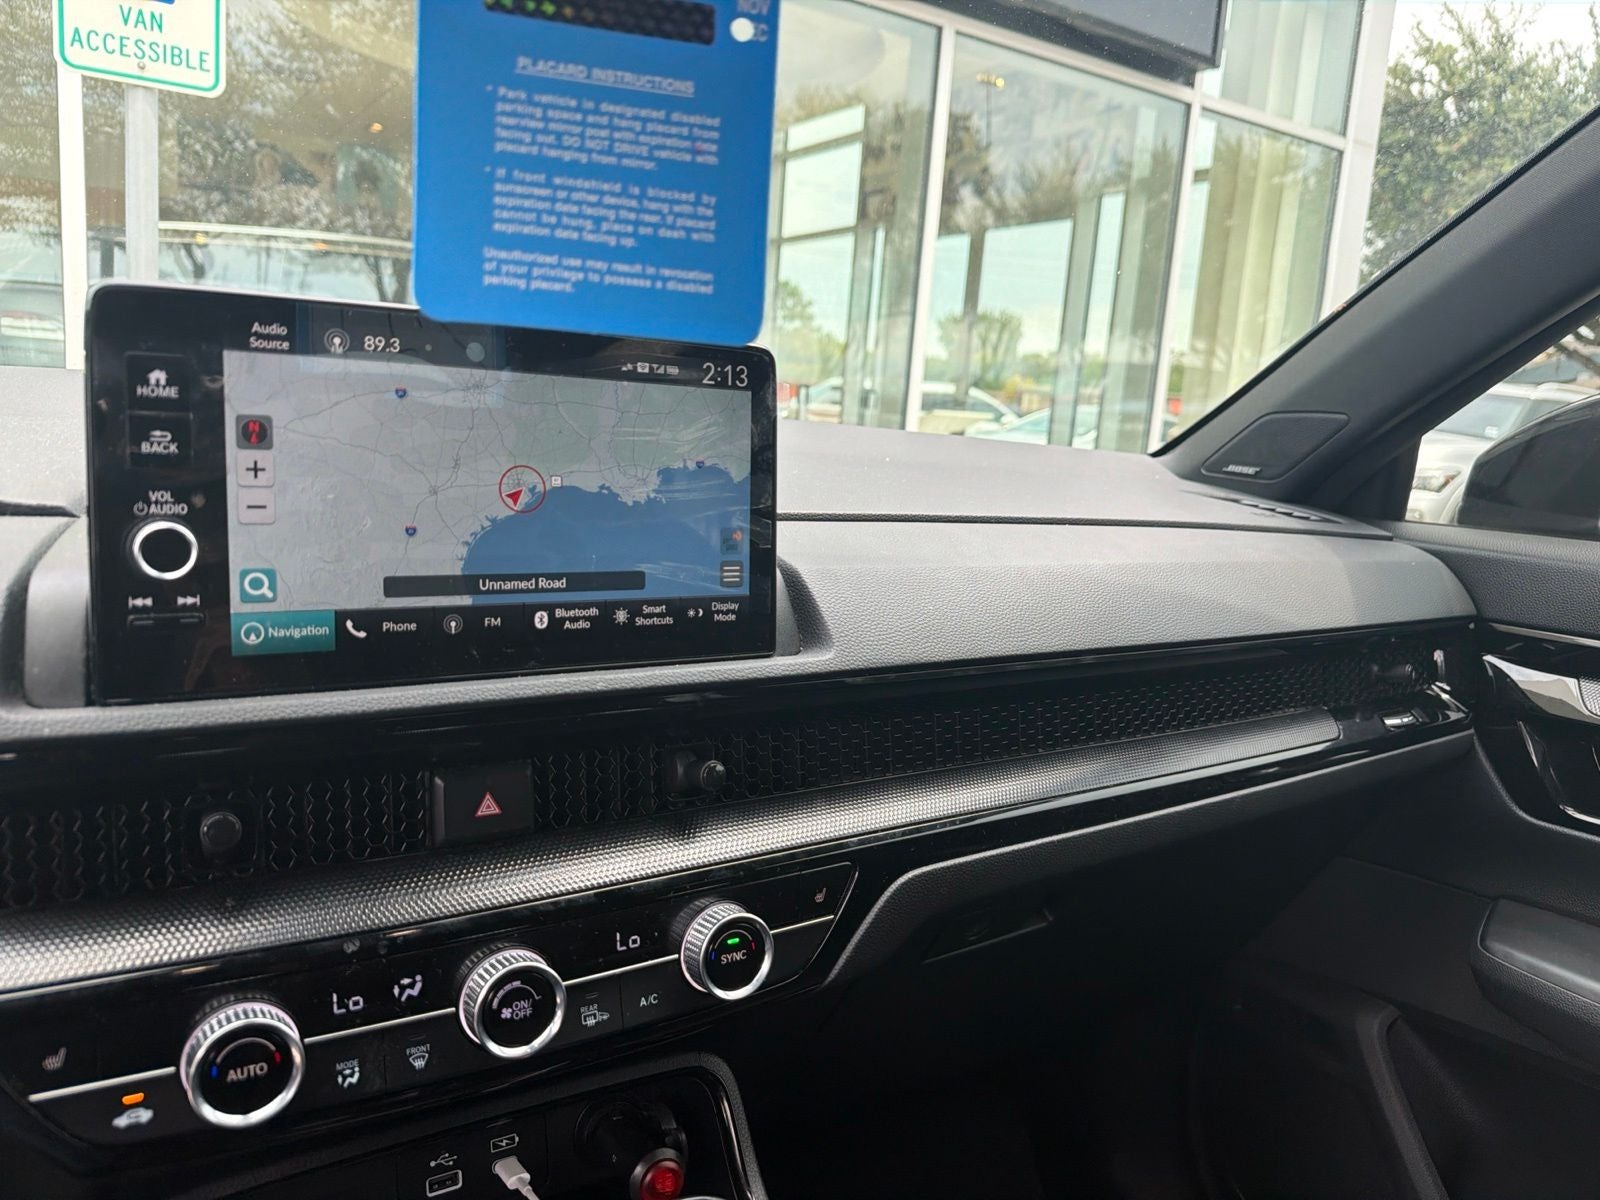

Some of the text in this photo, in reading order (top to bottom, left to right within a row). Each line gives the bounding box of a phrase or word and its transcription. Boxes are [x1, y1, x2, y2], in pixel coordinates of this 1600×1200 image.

[120, 5, 163, 33] VAN
[70, 27, 211, 73] ACCESSIBLE
[516, 58, 694, 96] PLACARD INSTRUCTIONS
[499, 87, 721, 127] Park vehicle in designated disabled
[496, 101, 719, 140] parking space and hang placard from
[639, 134, 692, 151] expiration
[495, 140, 538, 158] placard
[543, 147, 588, 164] hanging
[591, 153, 618, 166] from
[563, 135, 581, 148] DO
[586, 138, 609, 151] NOT
[614, 142, 649, 157] DRIVE
[697, 154, 718, 166] with
[514, 170, 546, 184] front
[553, 176, 621, 193] windshield
[630, 185, 640, 196] is
[648, 187, 696, 203] blocked
[703, 194, 717, 207] by
[556, 190, 568, 200] or
[571, 192, 599, 204] other
[494, 195, 552, 212] expiration
[583, 205, 616, 221] facing
[676, 217, 716, 231] placard
[494, 208, 537, 222] cannot
[541, 213, 557, 225] be
[602, 221, 634, 235] place
[639, 226, 654, 236] on
[659, 227, 686, 240] dash
[692, 231, 715, 243] with
[494, 222, 551, 238] expiration
[555, 228, 579, 240] date
[583, 232, 616, 247] facing
[484, 246, 559, 266] Unauthorized
[563, 257, 582, 268] use
[587, 260, 609, 273] may
[660, 267, 714, 282] revocation
[484, 260, 497, 272] of
[502, 263, 528, 276] your
[532, 266, 584, 283] privilege
[589, 272, 600, 283] to
[656, 281, 662, 290] a
[667, 280, 714, 295] disabled
[484, 274, 527, 290] parking
[251, 321, 288, 335] Audio
[249, 336, 290, 351] Source
[364, 336, 401, 353] 89.3
[702, 362, 749, 387] 2:13
[136, 384, 179, 399] HOME
[141, 440, 178, 455] BACK
[148, 490, 174, 503] VOL
[148, 502, 188, 516] AUDIO
[479, 577, 566, 591] Unnamed Road
[555, 607, 599, 618] Bluetooth
[642, 604, 666, 614] Smart
[711, 601, 739, 613] Display
[484, 617, 501, 628] FM
[564, 618, 591, 630] Audio
[635, 614, 674, 626] Shortcuts
[714, 611, 736, 622] Mode
[268, 623, 330, 639] Navigation
[382, 621, 417, 633] Phone
[616, 932, 640, 951] Lo
[721, 950, 747, 965] SYNC
[331, 992, 364, 1015] Lo
[513, 998, 533, 1011] ON/
[639, 993, 658, 1007] A/C
[513, 1008, 533, 1020] OFF
[580, 1004, 598, 1013] REAR
[406, 1044, 431, 1056] FRONT
[336, 1058, 359, 1071] MODE
[226, 1062, 269, 1083] AUTO
